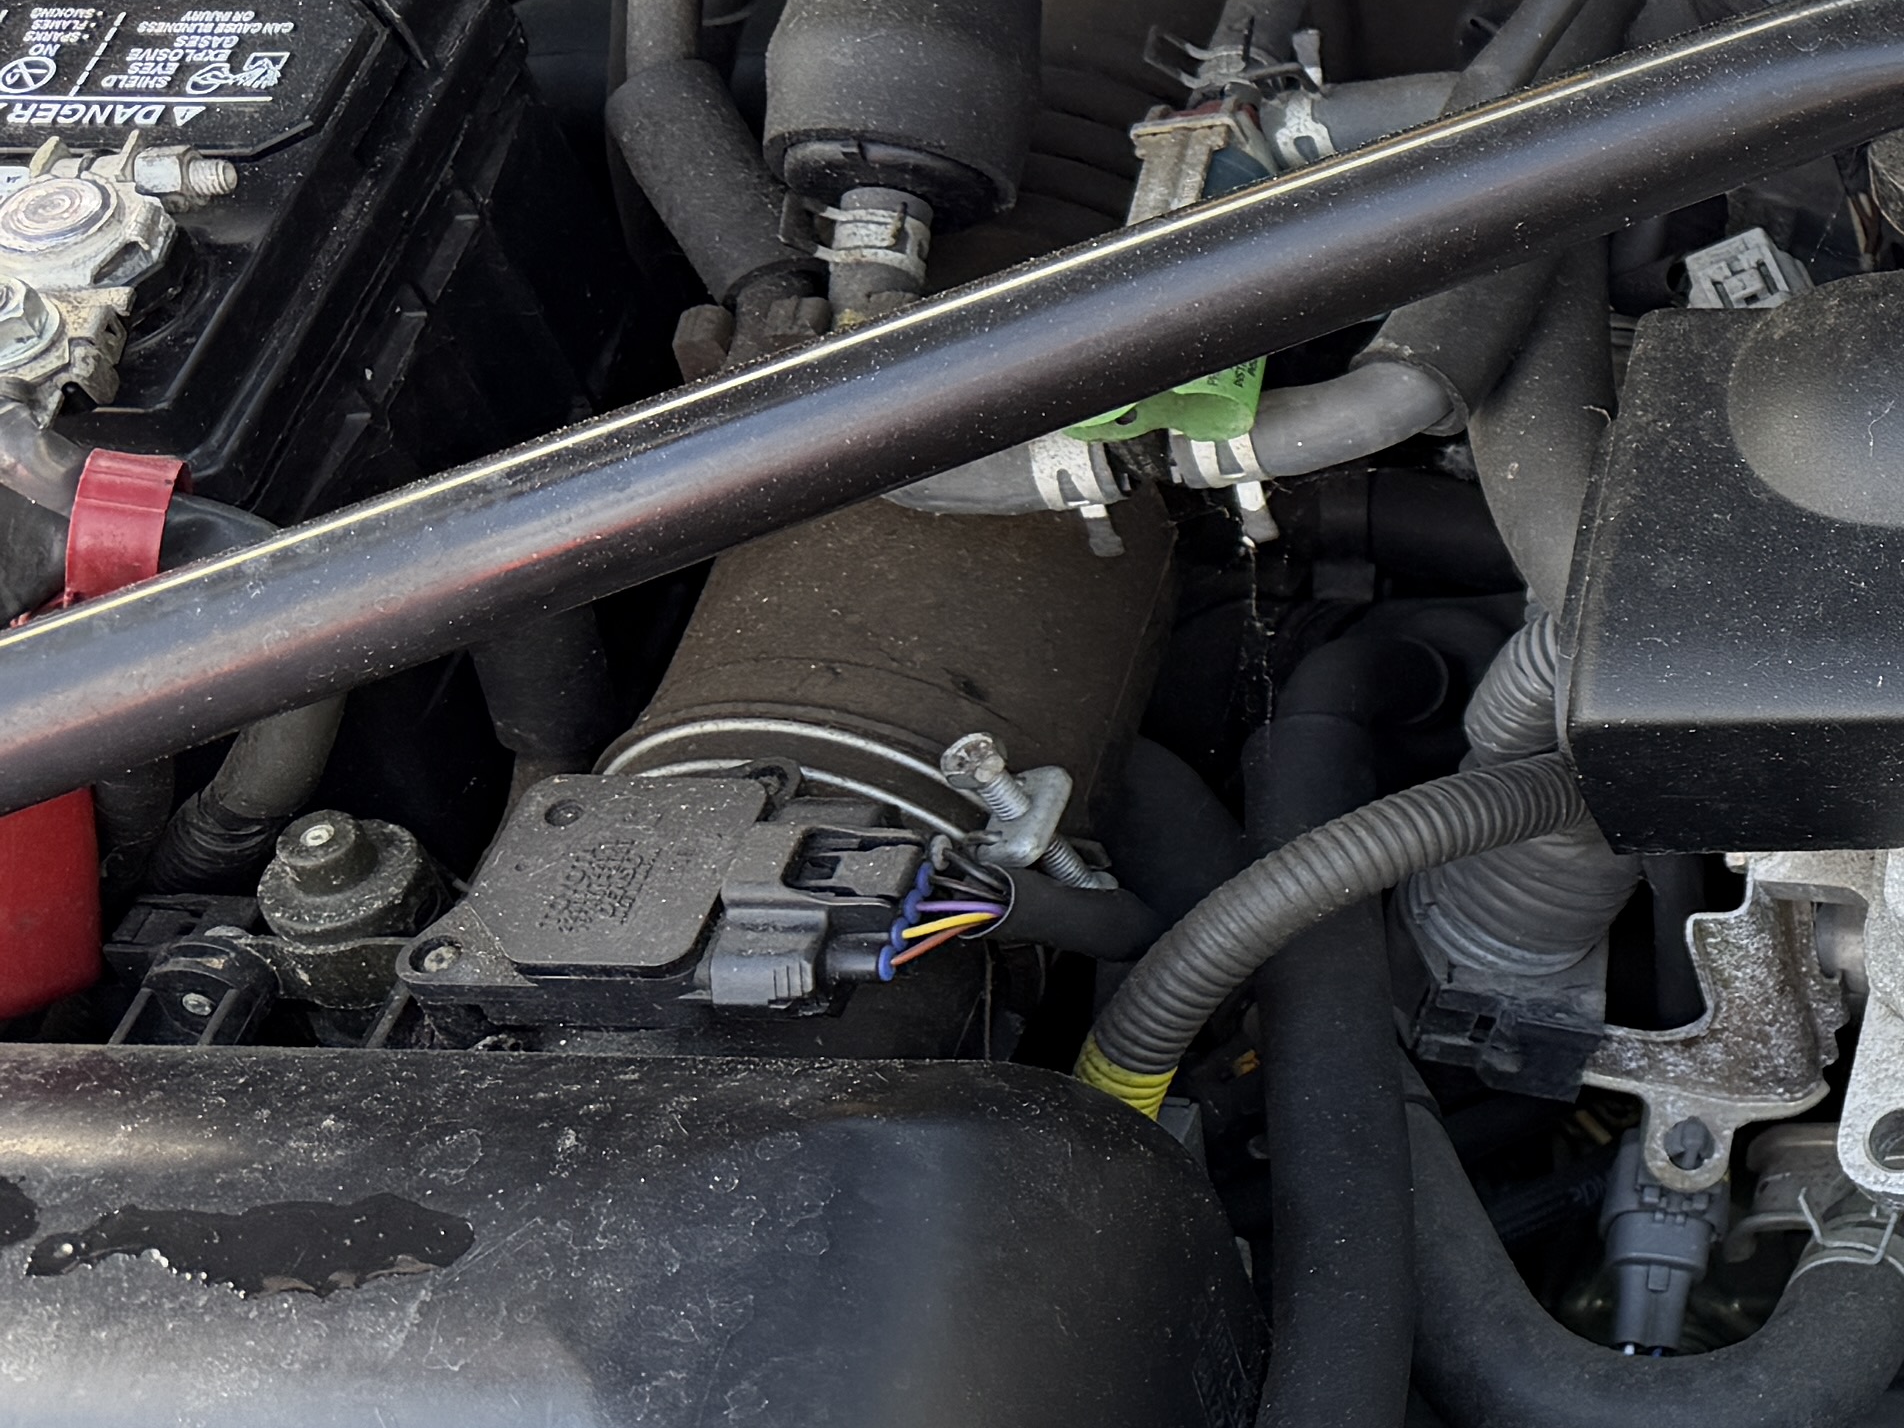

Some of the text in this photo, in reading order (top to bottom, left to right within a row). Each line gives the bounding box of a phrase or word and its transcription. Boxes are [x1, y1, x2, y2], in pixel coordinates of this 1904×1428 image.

[29, 7, 97, 20] SMOKING
[181, 10, 255, 22] OR INJURY
[30, 19, 90, 30] FLAMES
[137, 20, 295, 35] CAN CAUSE BLINDNESS
[23, 30, 83, 43] SPARKS
[174, 34, 240, 48] GASES
[28, 42, 61, 56] NO
[126, 47, 232, 62] EXPLOSIVE
[127, 61, 180, 75] EYES
[100, 74, 171, 88] SHIELD
[6, 101, 166, 126] DANGER
